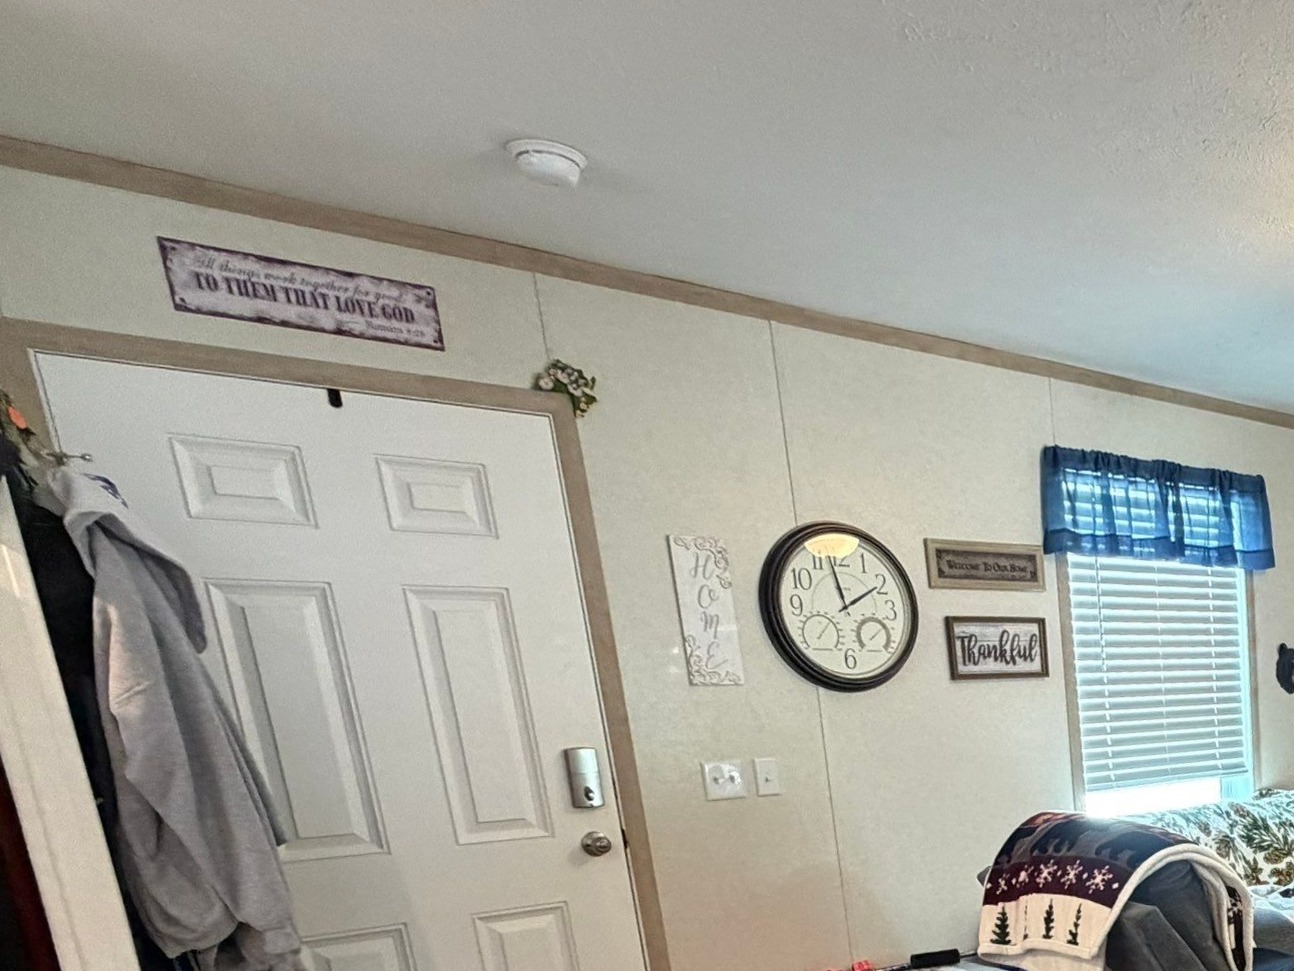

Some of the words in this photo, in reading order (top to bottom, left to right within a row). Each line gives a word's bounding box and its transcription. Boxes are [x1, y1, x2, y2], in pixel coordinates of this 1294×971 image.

[194, 271, 219, 292] TO
[221, 275, 277, 303] THEM
[280, 284, 329, 310] THAT
[334, 294, 379, 319] LOVE
[380, 302, 416, 324] GOD
[860, 552, 868, 574] 1
[791, 567, 813, 591] 10
[874, 573, 889, 596] 2
[790, 593, 804, 618] 9
[884, 599, 898, 622] 3
[844, 648, 858, 671] 6
[955, 630, 1038, 667] Thankful
